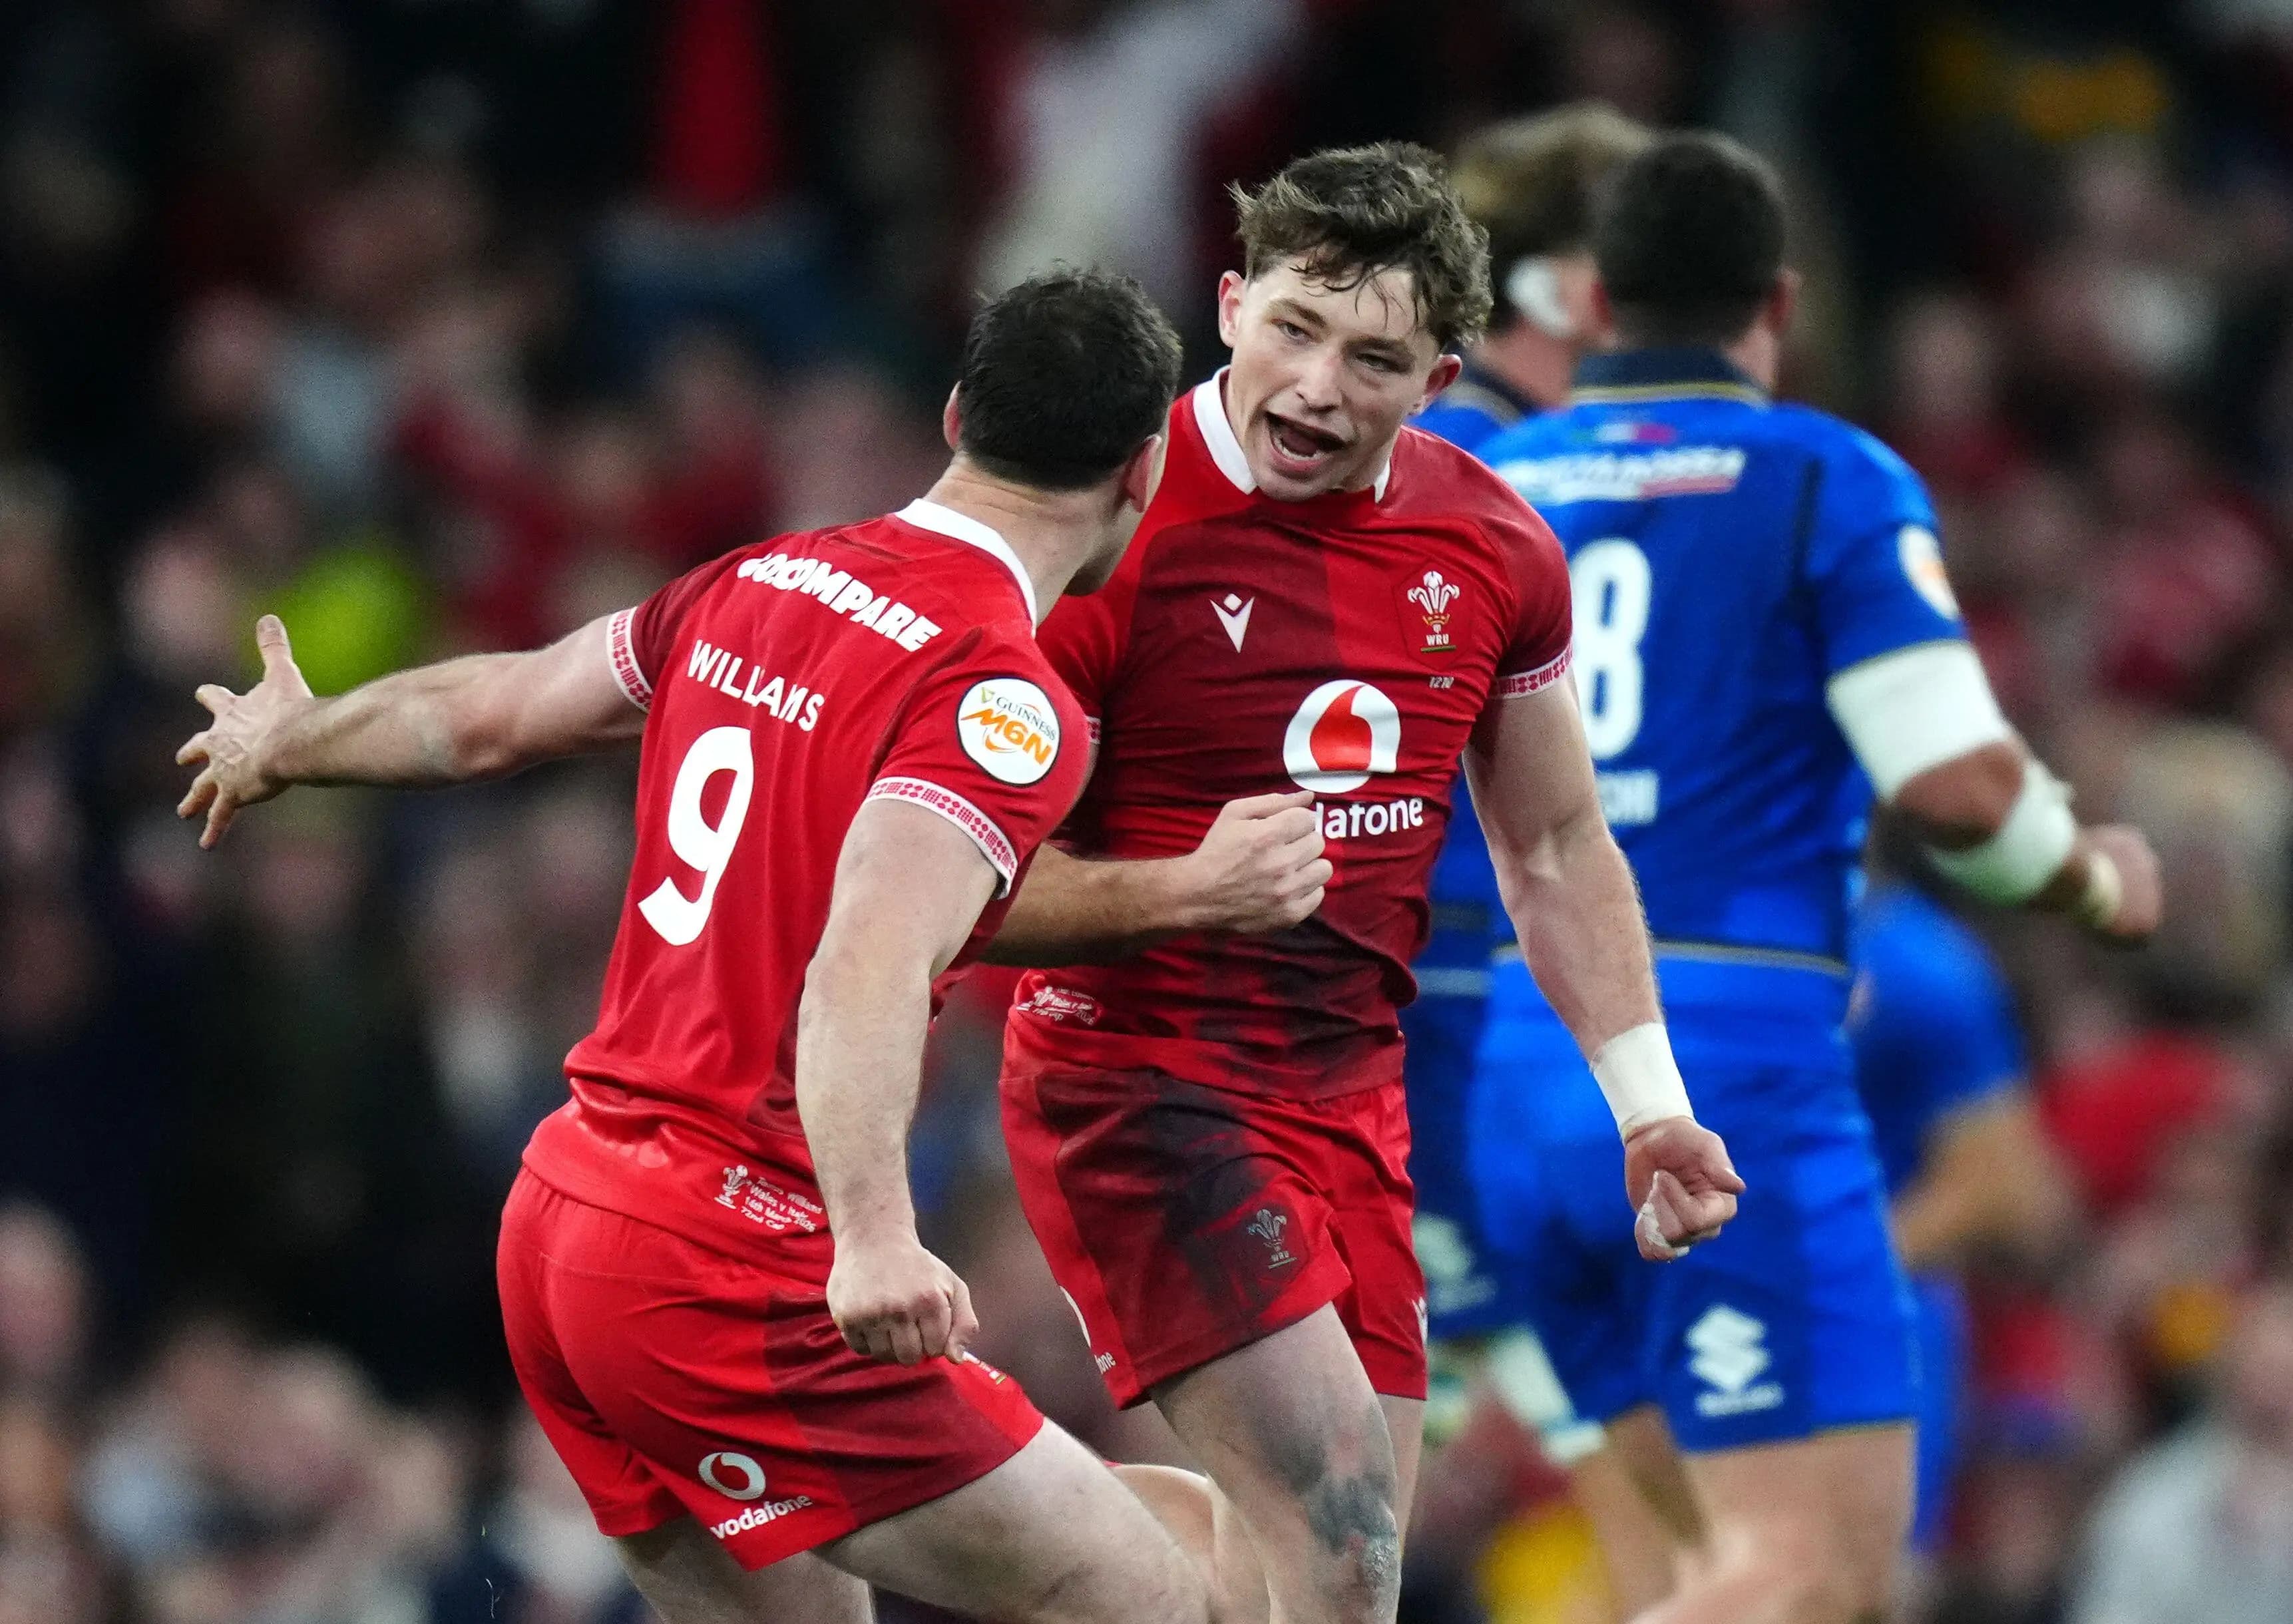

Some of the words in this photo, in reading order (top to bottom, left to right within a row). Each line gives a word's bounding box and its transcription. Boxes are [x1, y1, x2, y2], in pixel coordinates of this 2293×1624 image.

[1426, 633, 1450, 646] WRU
[687, 638, 825, 732] WILLAMS
[996, 696, 1056, 741] GUINNESS
[638, 725, 754, 946] 9
[709, 1494, 813, 1539] vodafone
